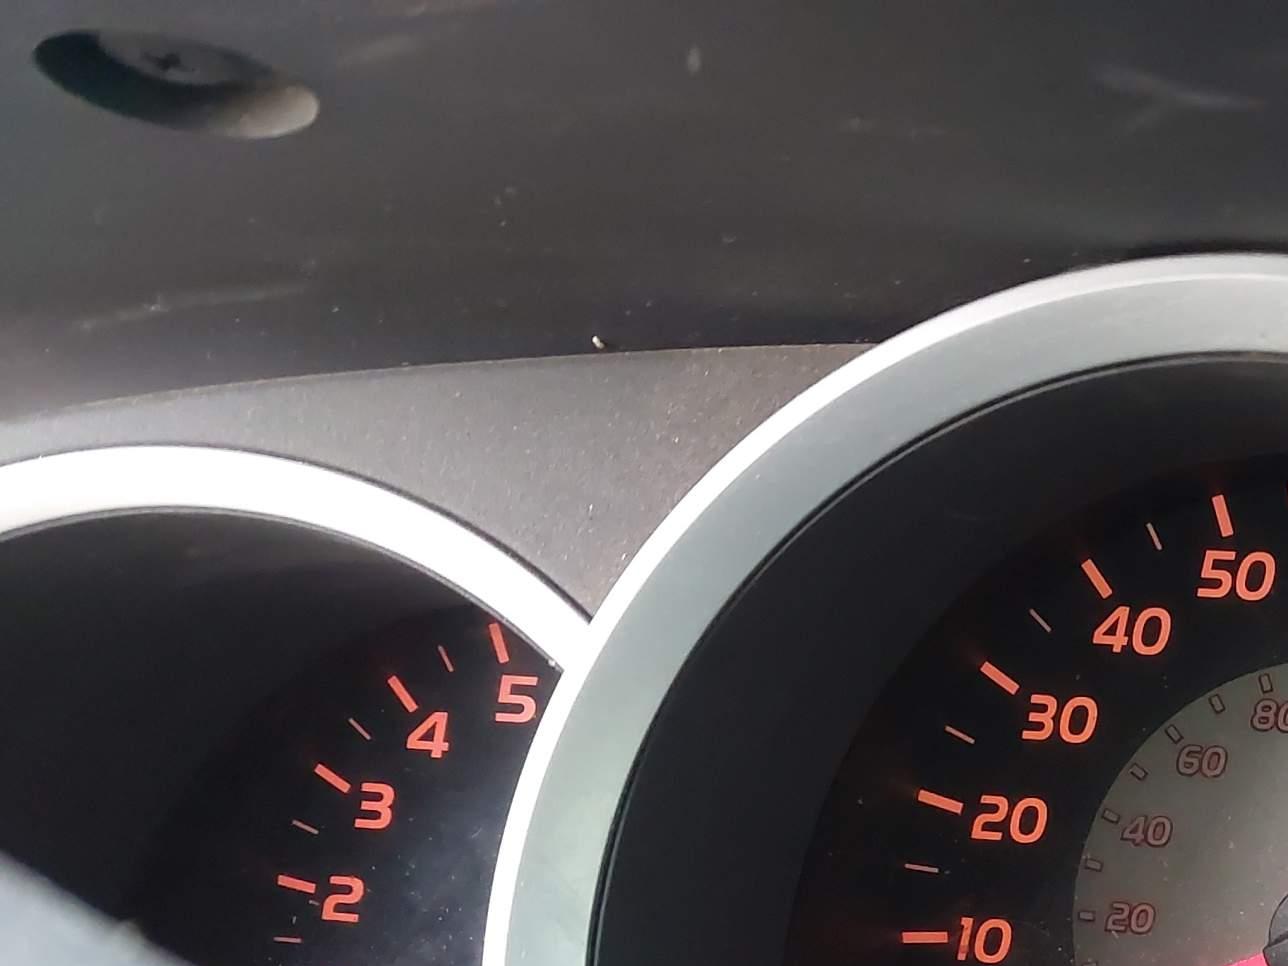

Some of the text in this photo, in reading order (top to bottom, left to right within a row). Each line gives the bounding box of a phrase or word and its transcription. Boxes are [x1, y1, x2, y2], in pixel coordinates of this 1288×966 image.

[1197, 549, 1276, 601] 50
[1092, 605, 1172, 655] 40
[495, 674, 538, 723] 5
[1021, 694, 1098, 744] 30
[406, 711, 449, 758] 4
[1176, 744, 1228, 778] 60
[354, 782, 395, 830] 3
[970, 794, 1048, 843] 20
[1120, 815, 1173, 848] 40
[321, 875, 365, 923] 2
[1105, 902, 1156, 935] 20
[956, 917, 1012, 963] 10
